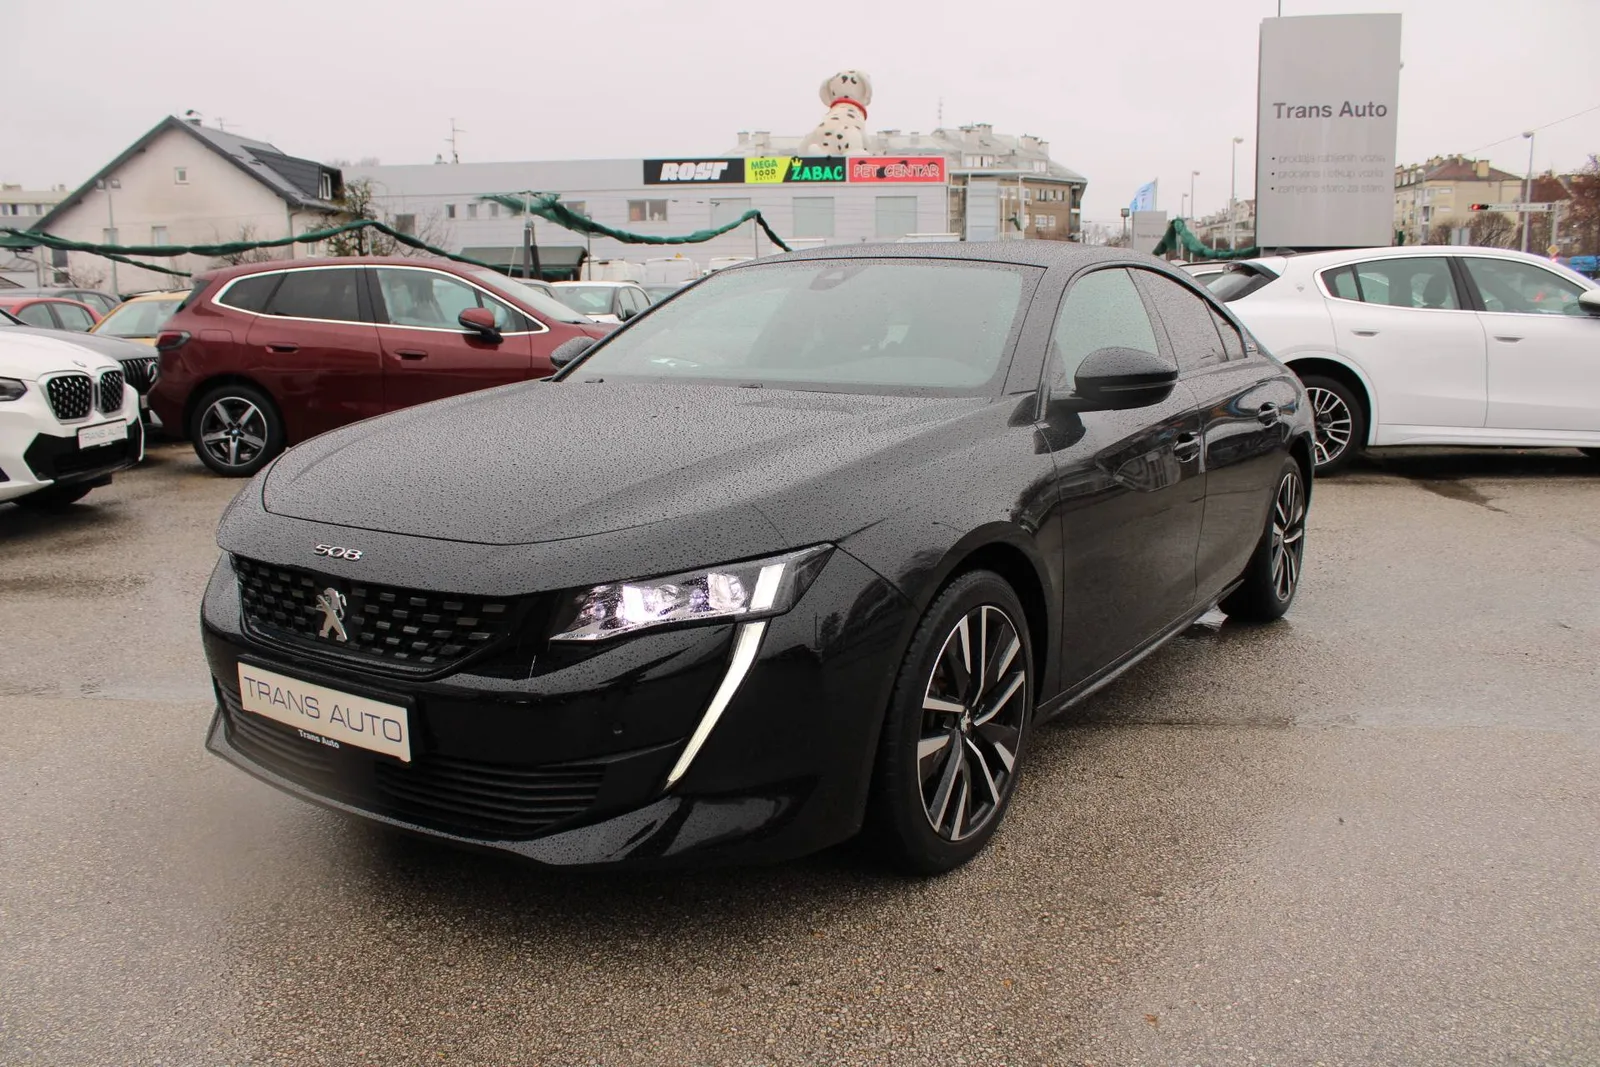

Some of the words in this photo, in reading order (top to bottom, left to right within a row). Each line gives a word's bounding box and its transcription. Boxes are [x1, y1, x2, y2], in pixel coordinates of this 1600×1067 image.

[1272, 102, 1333, 119] Trans
[1338, 100, 1388, 118] Auto
[659, 161, 729, 181] ROST
[751, 159, 778, 170] MEGA
[754, 168, 777, 177] FOOD
[853, 164, 880, 178] PET
[884, 163, 940, 178] CENTAR
[313, 543, 363, 561] 508
[243, 676, 321, 719] TRANS
[329, 704, 402, 743] AUTO
[297, 729, 321, 743] Trans
[321, 736, 340, 749] Auto
